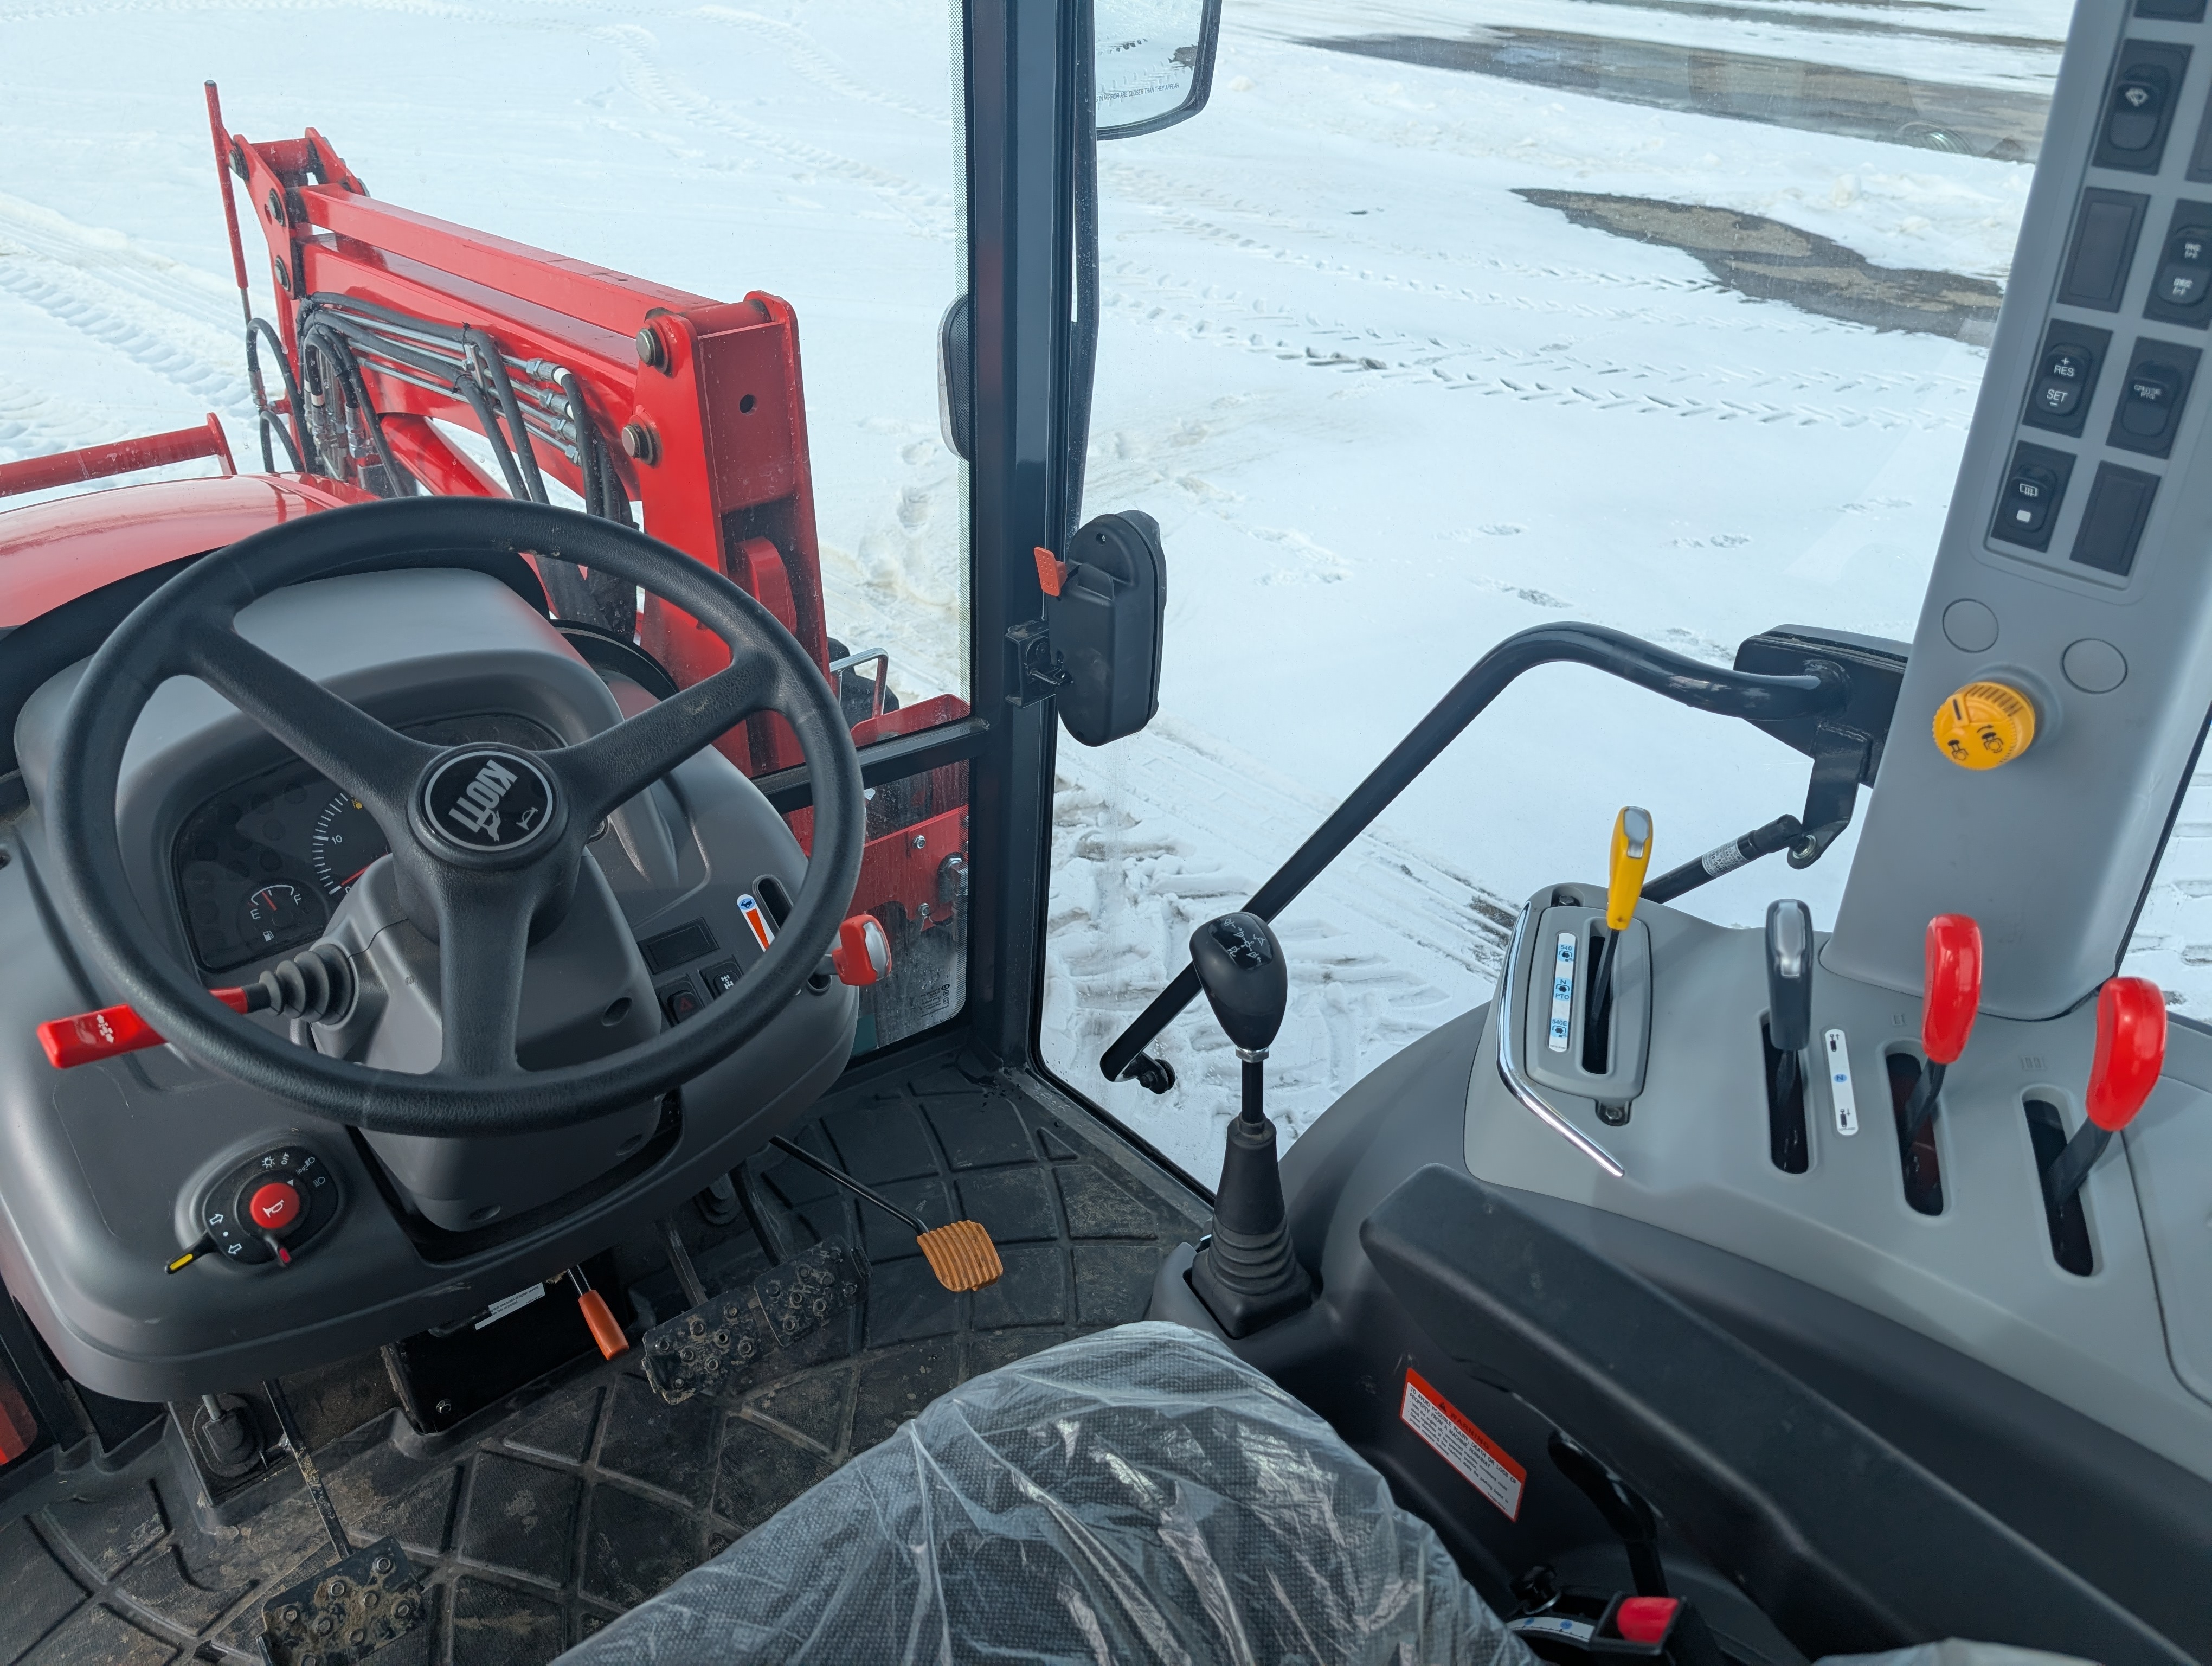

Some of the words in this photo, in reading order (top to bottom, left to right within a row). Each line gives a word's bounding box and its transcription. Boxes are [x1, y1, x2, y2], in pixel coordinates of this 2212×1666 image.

[1129, 88, 1144, 97] CLOSER
[1165, 82, 1179, 91] APPEAR
[2054, 364, 2075, 377] RES
[2046, 389, 2068, 402] SET
[448, 759, 518, 833] KIOTI
[331, 835, 343, 844] 10
[293, 894, 302, 905] F
[250, 908, 261, 920] E
[281, 1152, 290, 1165] OFF
[1409, 1392, 1430, 1414] PROPERTY
[1431, 1412, 1443, 1426] FROM
[1449, 1428, 1468, 1449] MACHINE
[1469, 1446, 1490, 1469] RUNAWAY
[1410, 1386, 1416, 1395] TO
[1417, 1393, 1430, 1407] AVOID
[1431, 1405, 1451, 1427] POSSIBLE
[1453, 1425, 1470, 1444] INJURY,
[1471, 1441, 1486, 1458] DEATH
[1487, 1456, 1494, 1465] OR
[1496, 1464, 1508, 1478] LOSS
[1510, 1476, 1516, 1485] OF
[1450, 1411, 1490, 1450] WARNING
[1464, 1450, 1478, 1465] machine
[1480, 1476, 1493, 1490] parking
